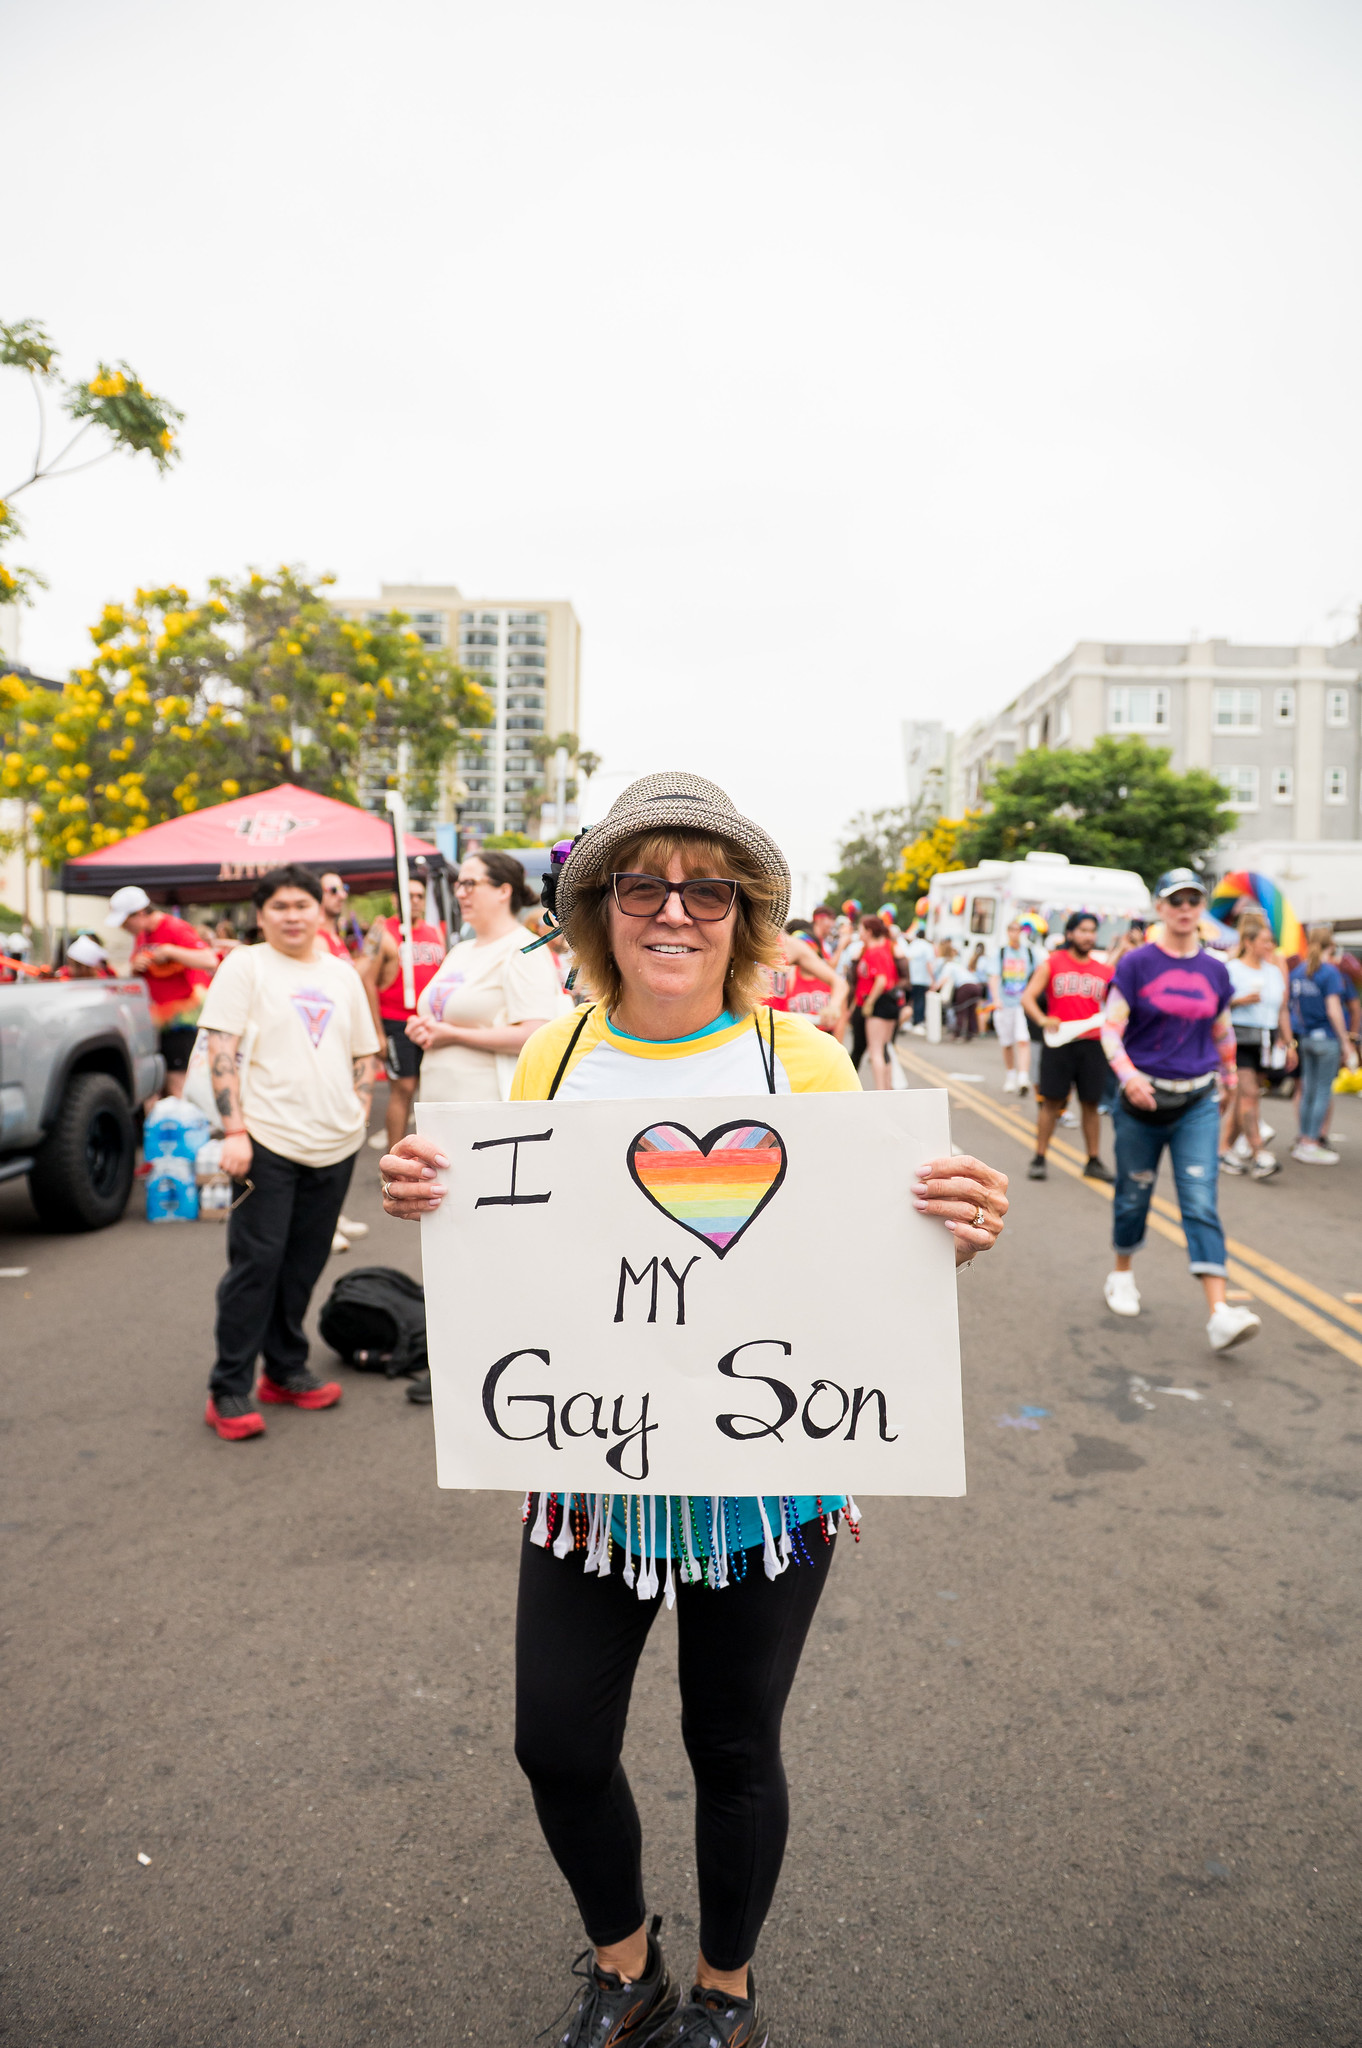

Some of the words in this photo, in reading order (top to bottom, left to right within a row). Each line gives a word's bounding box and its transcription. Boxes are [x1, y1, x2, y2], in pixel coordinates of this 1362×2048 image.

[471, 1127, 554, 1210] I
[613, 1255, 702, 1326] MY
[481, 1348, 659, 1481] Gay
[715, 1339, 899, 1443] Son
